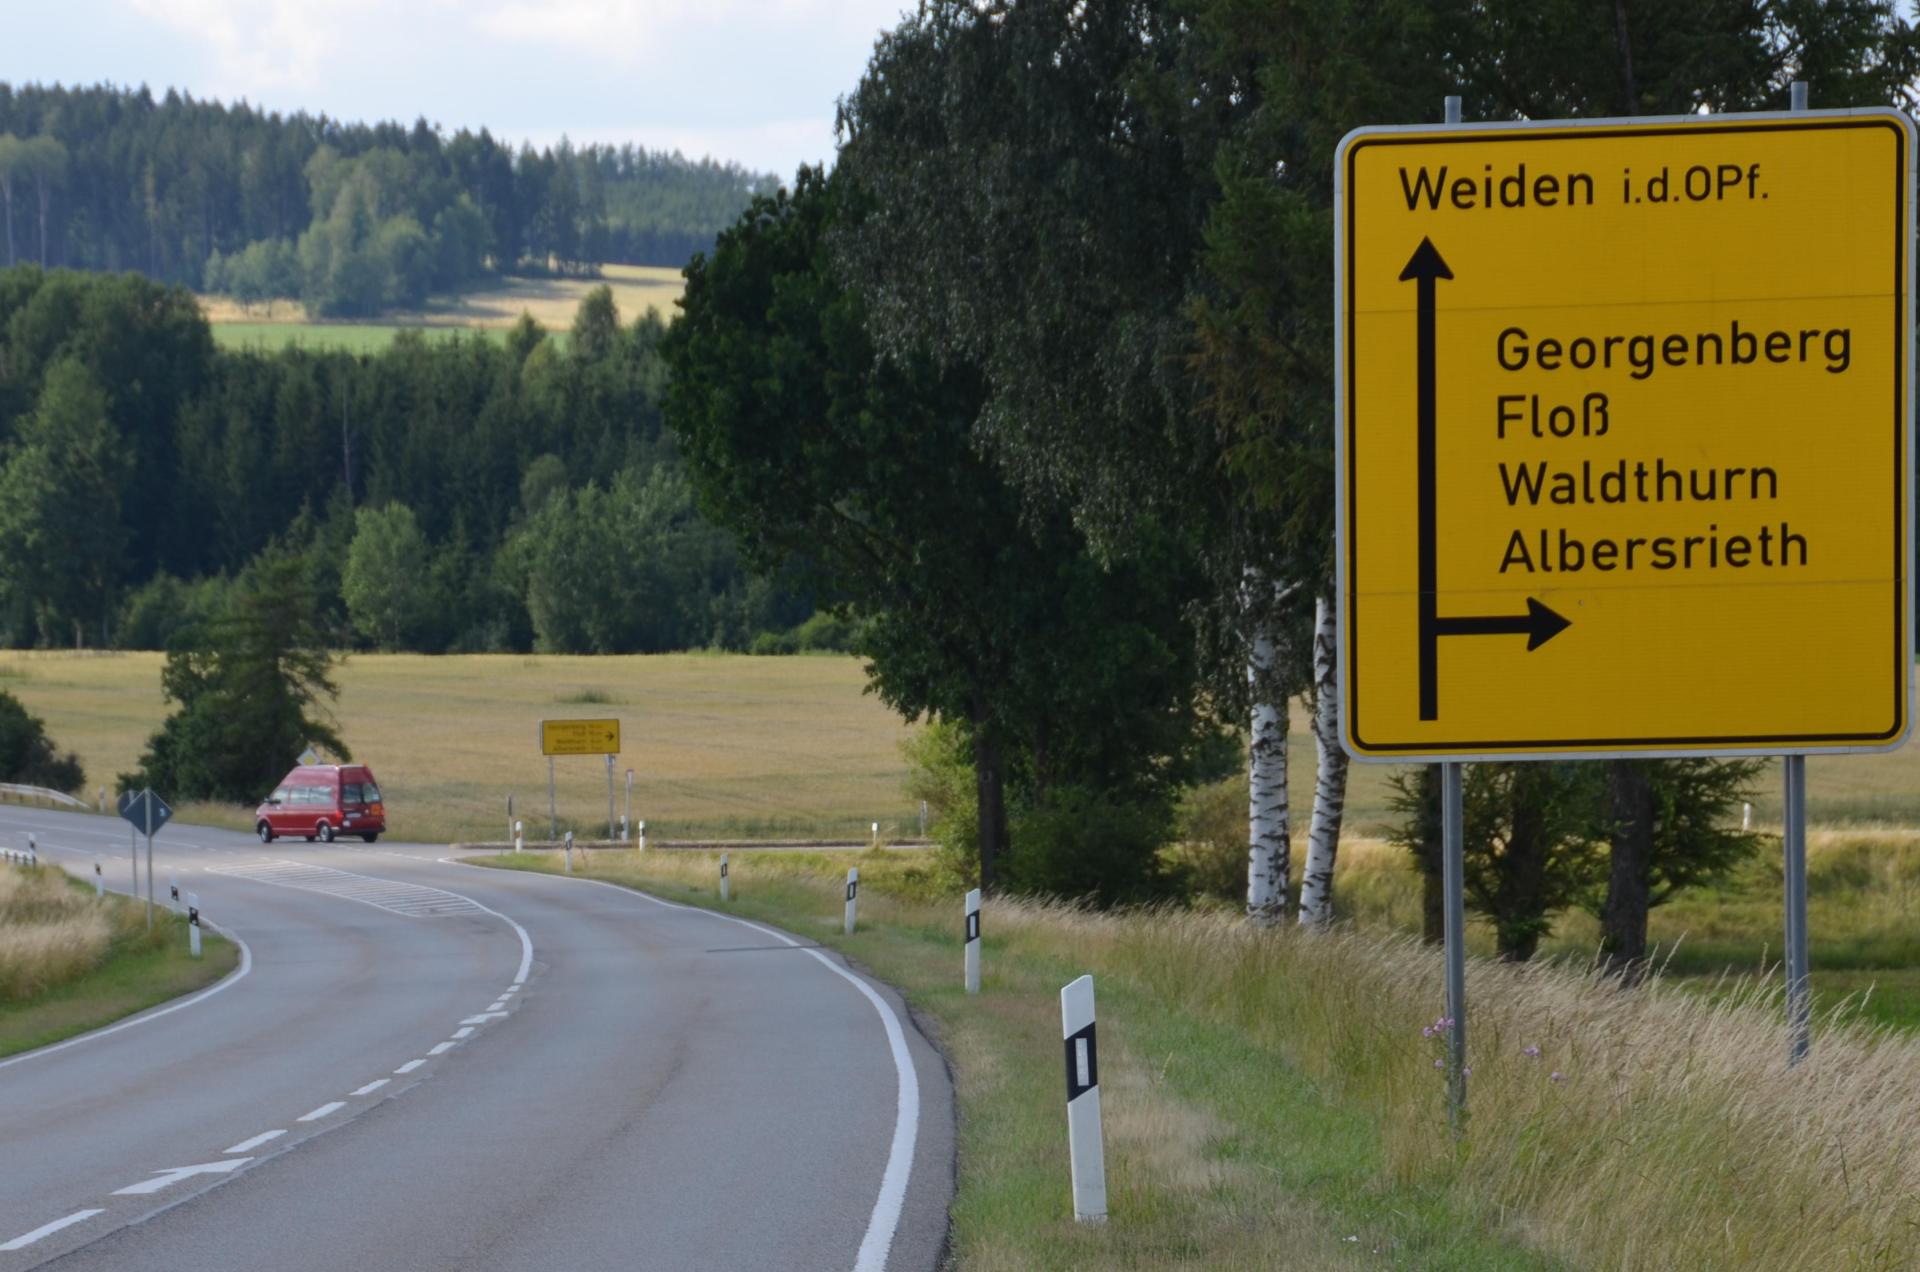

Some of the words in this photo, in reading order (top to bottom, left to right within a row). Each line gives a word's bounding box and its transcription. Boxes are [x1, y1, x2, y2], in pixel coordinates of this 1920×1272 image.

[1399, 164, 1594, 211] Weiden
[1497, 321, 1851, 380] Georgenberg
[1497, 393, 1609, 438] Floß
[1498, 459, 1777, 506] Waldthurn
[1499, 523, 1808, 573] Albersrieth
